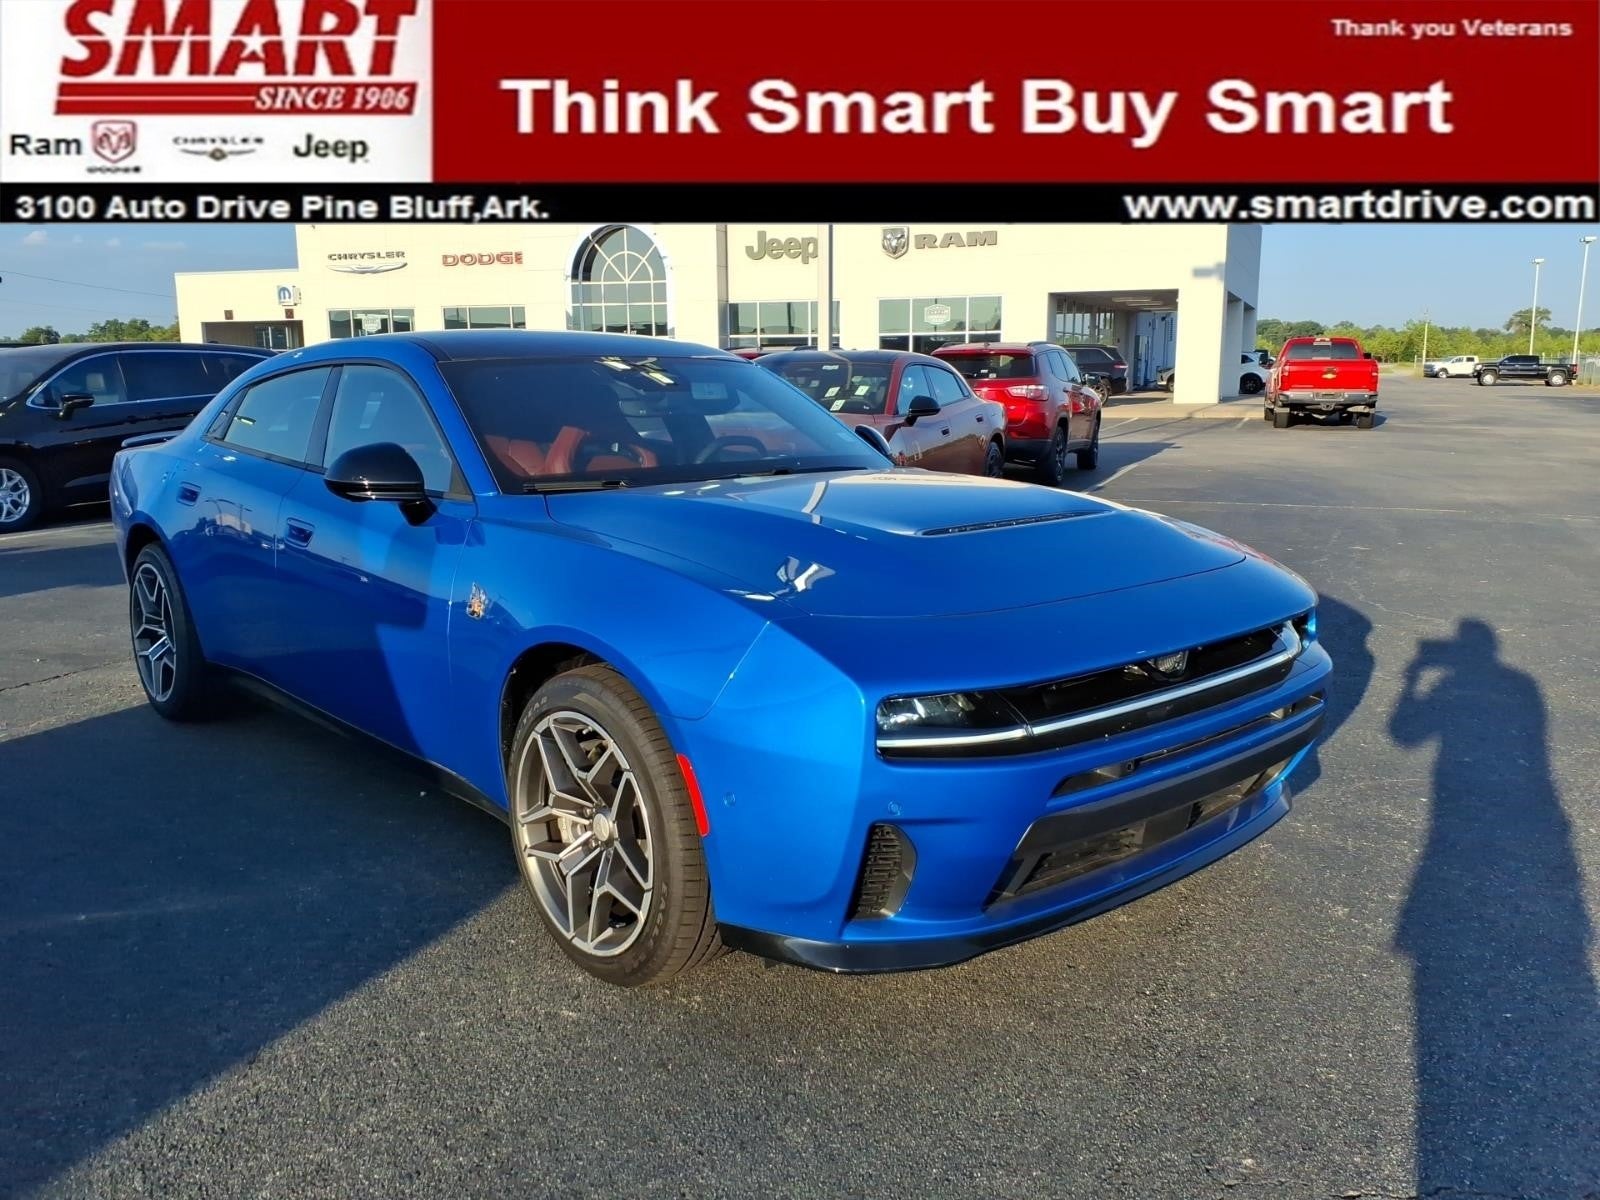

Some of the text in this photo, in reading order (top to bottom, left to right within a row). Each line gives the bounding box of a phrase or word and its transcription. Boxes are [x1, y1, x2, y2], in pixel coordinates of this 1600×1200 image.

[745, 230, 819, 264] Jeep
[914, 231, 998, 249] RAM
[328, 251, 405, 261] CHRYSLER
[442, 252, 523, 267] DODGE
